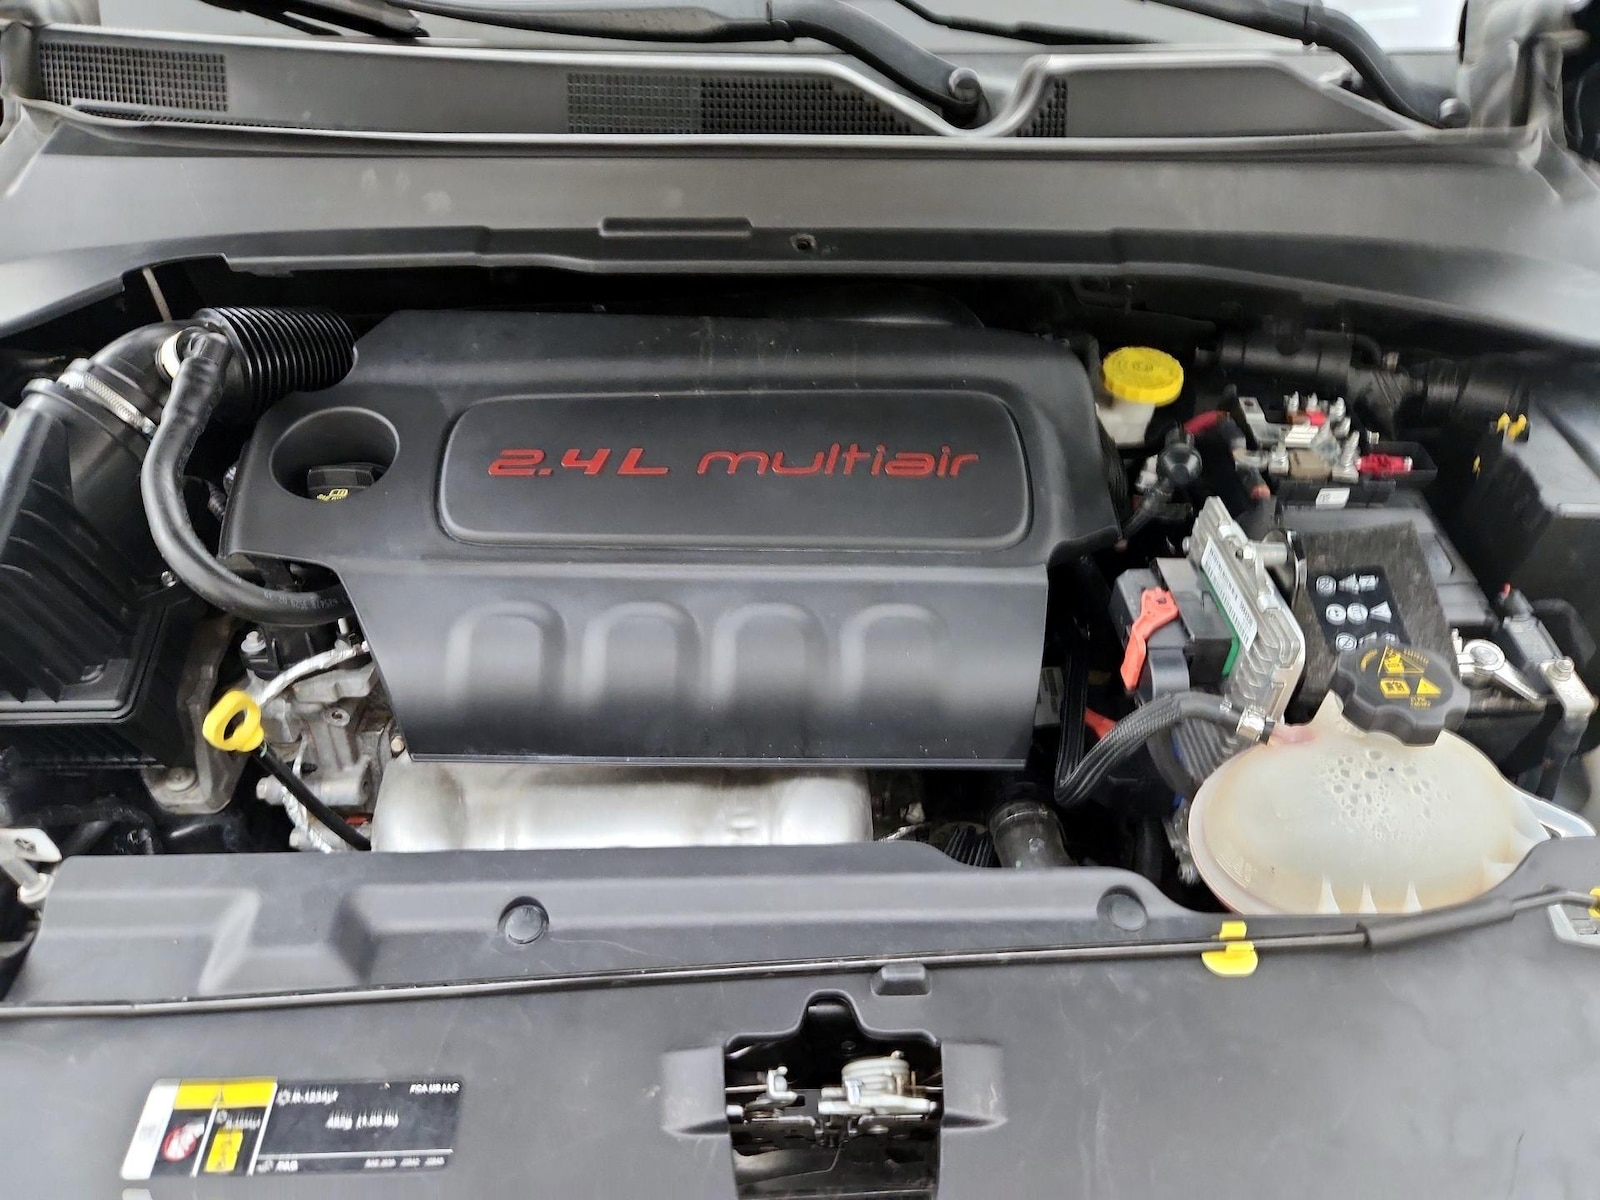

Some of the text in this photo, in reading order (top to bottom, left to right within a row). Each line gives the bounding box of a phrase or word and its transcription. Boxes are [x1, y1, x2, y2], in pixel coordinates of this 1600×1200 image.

[697, 442, 980, 477] multiair
[409, 1083, 428, 1094] FCA
[428, 1083, 442, 1094] US
